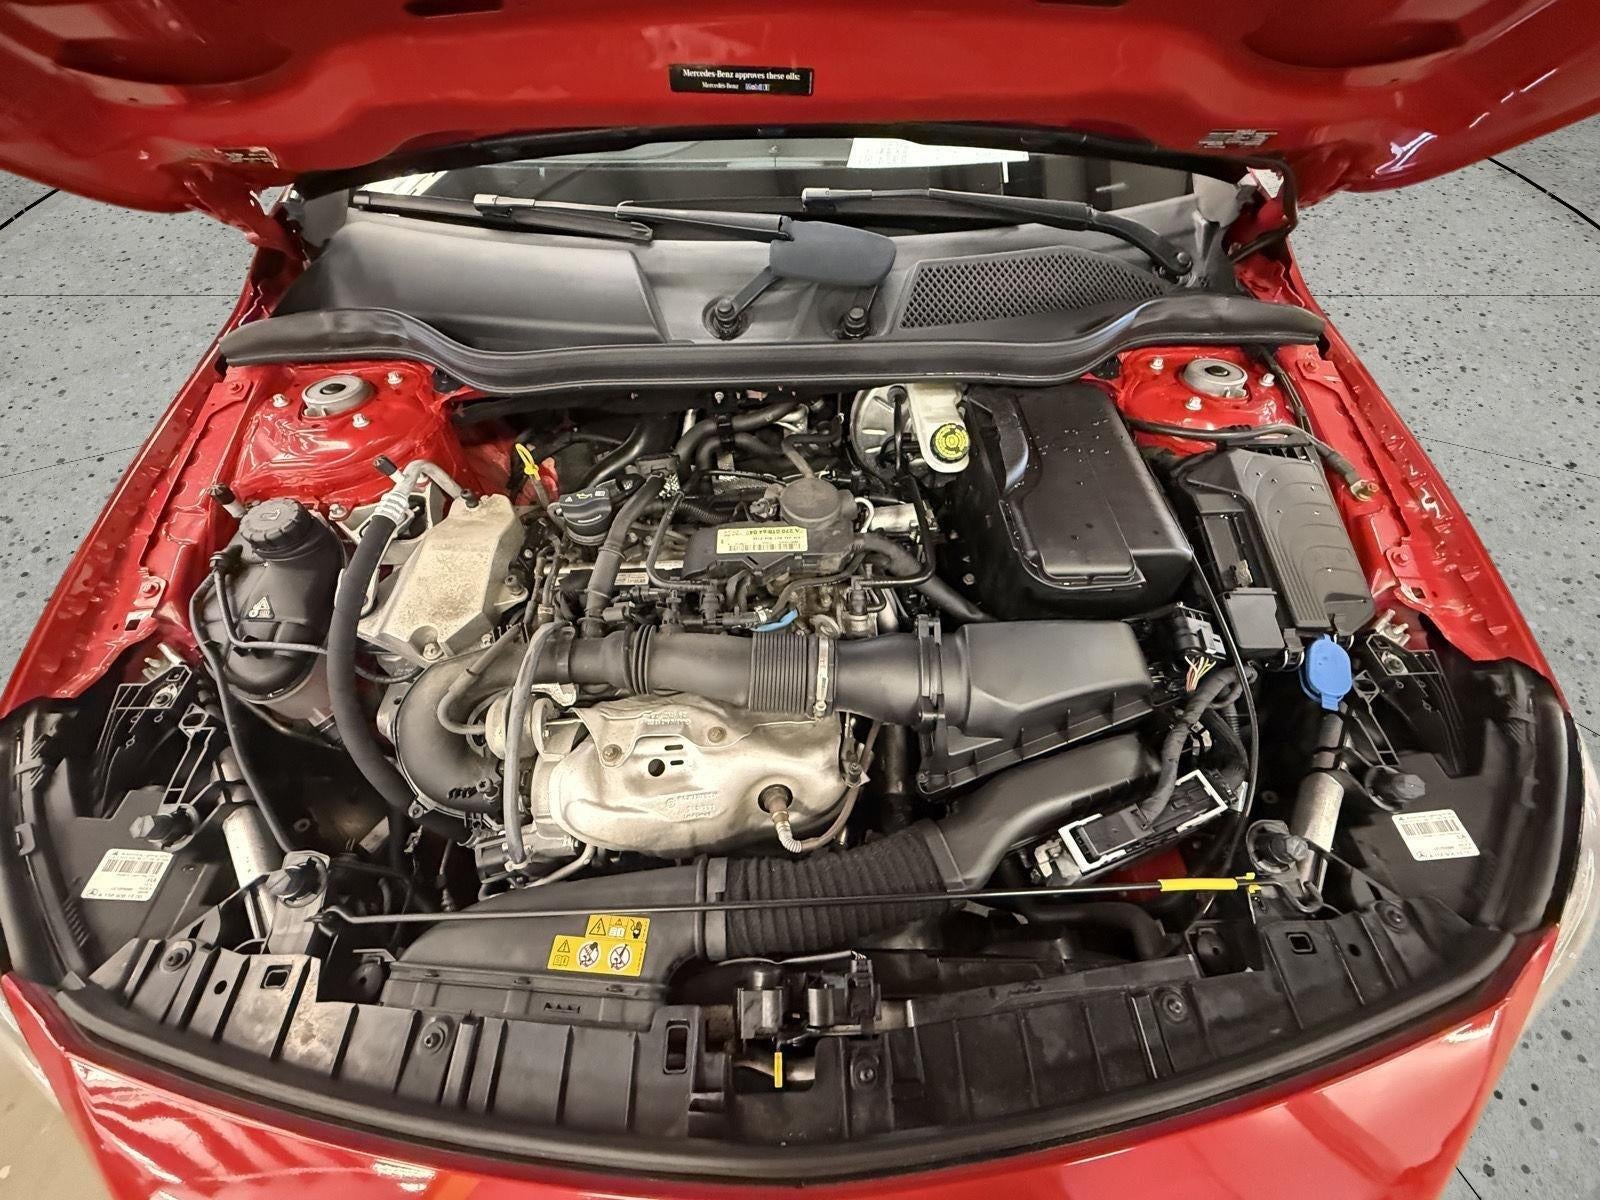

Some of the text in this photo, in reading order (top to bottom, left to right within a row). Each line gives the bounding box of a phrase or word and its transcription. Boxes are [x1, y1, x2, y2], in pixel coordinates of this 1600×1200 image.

[683, 69, 734, 79] Mercedes-Benz
[735, 72, 765, 80] approves
[766, 71, 785, 80] these
